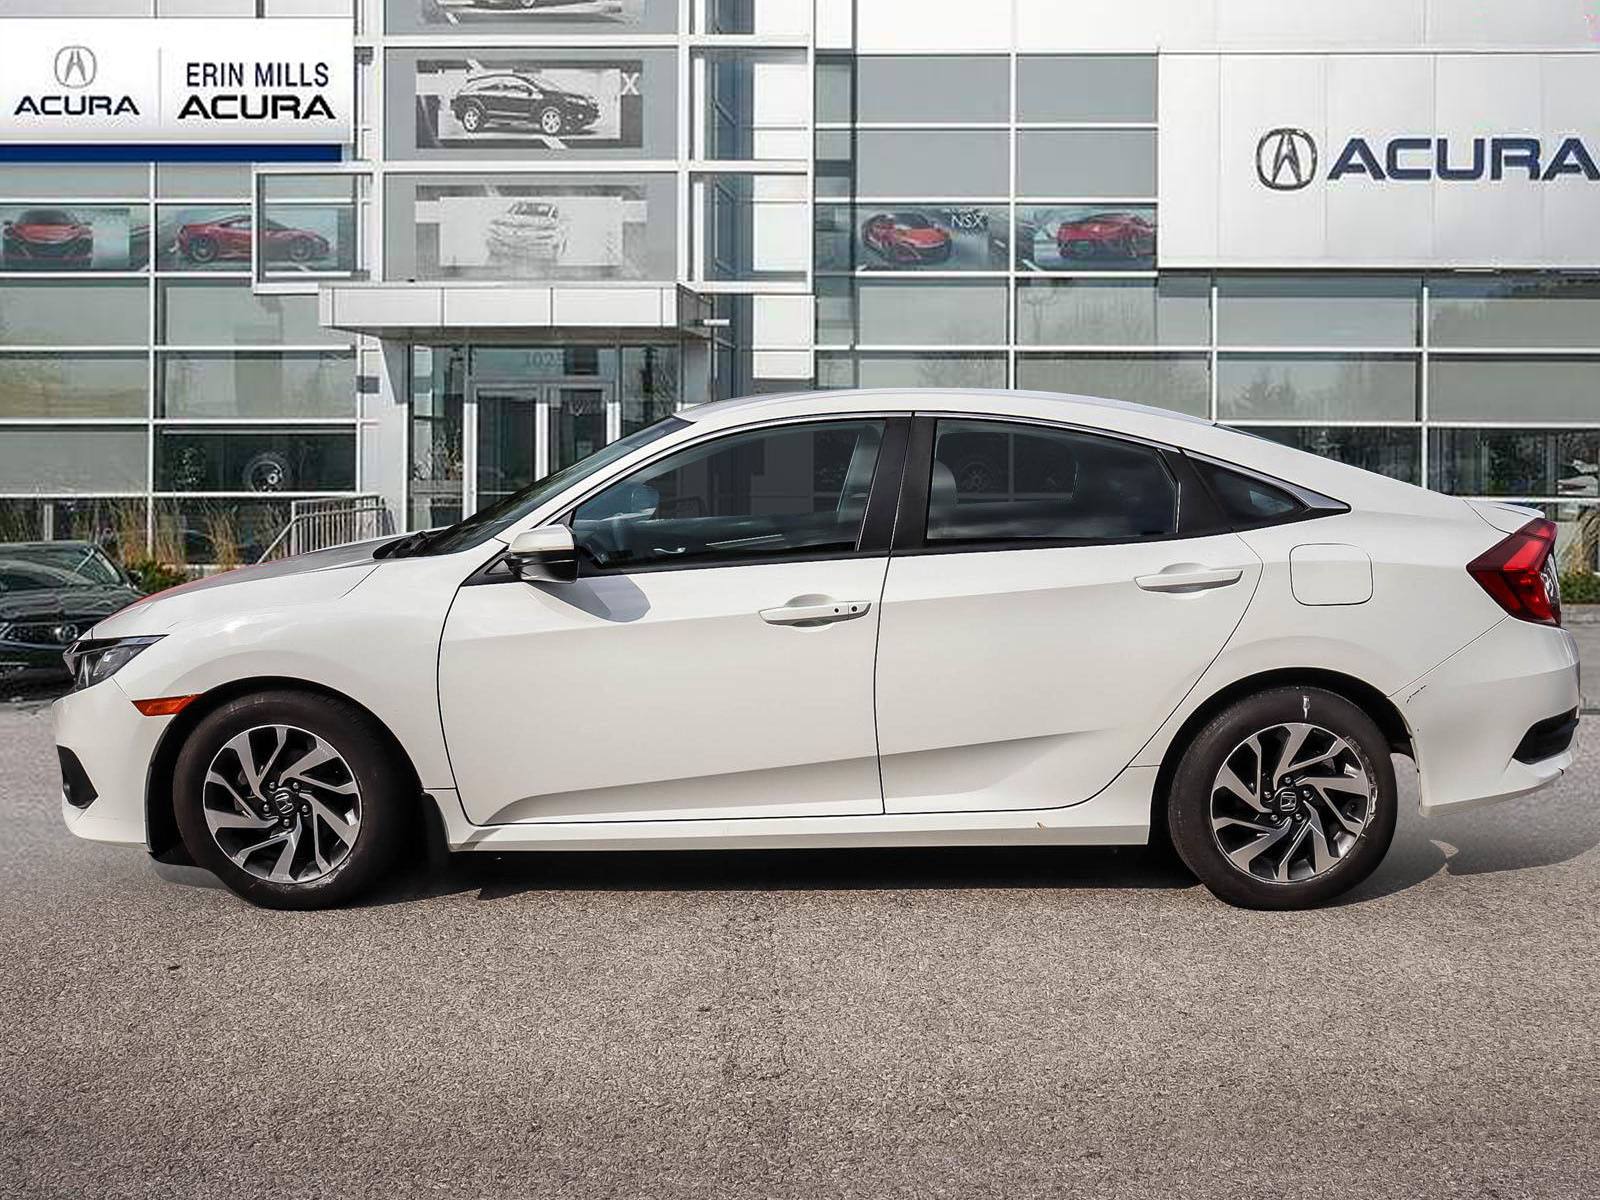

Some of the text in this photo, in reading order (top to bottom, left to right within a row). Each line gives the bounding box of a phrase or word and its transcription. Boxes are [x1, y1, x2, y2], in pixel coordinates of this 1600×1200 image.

[187, 62, 329, 88] ERIN MILLS
[14, 96, 140, 116] ACURA
[177, 95, 337, 120] ACURA
[1327, 137, 1600, 181] ACURA
[951, 212, 988, 229] NSX
